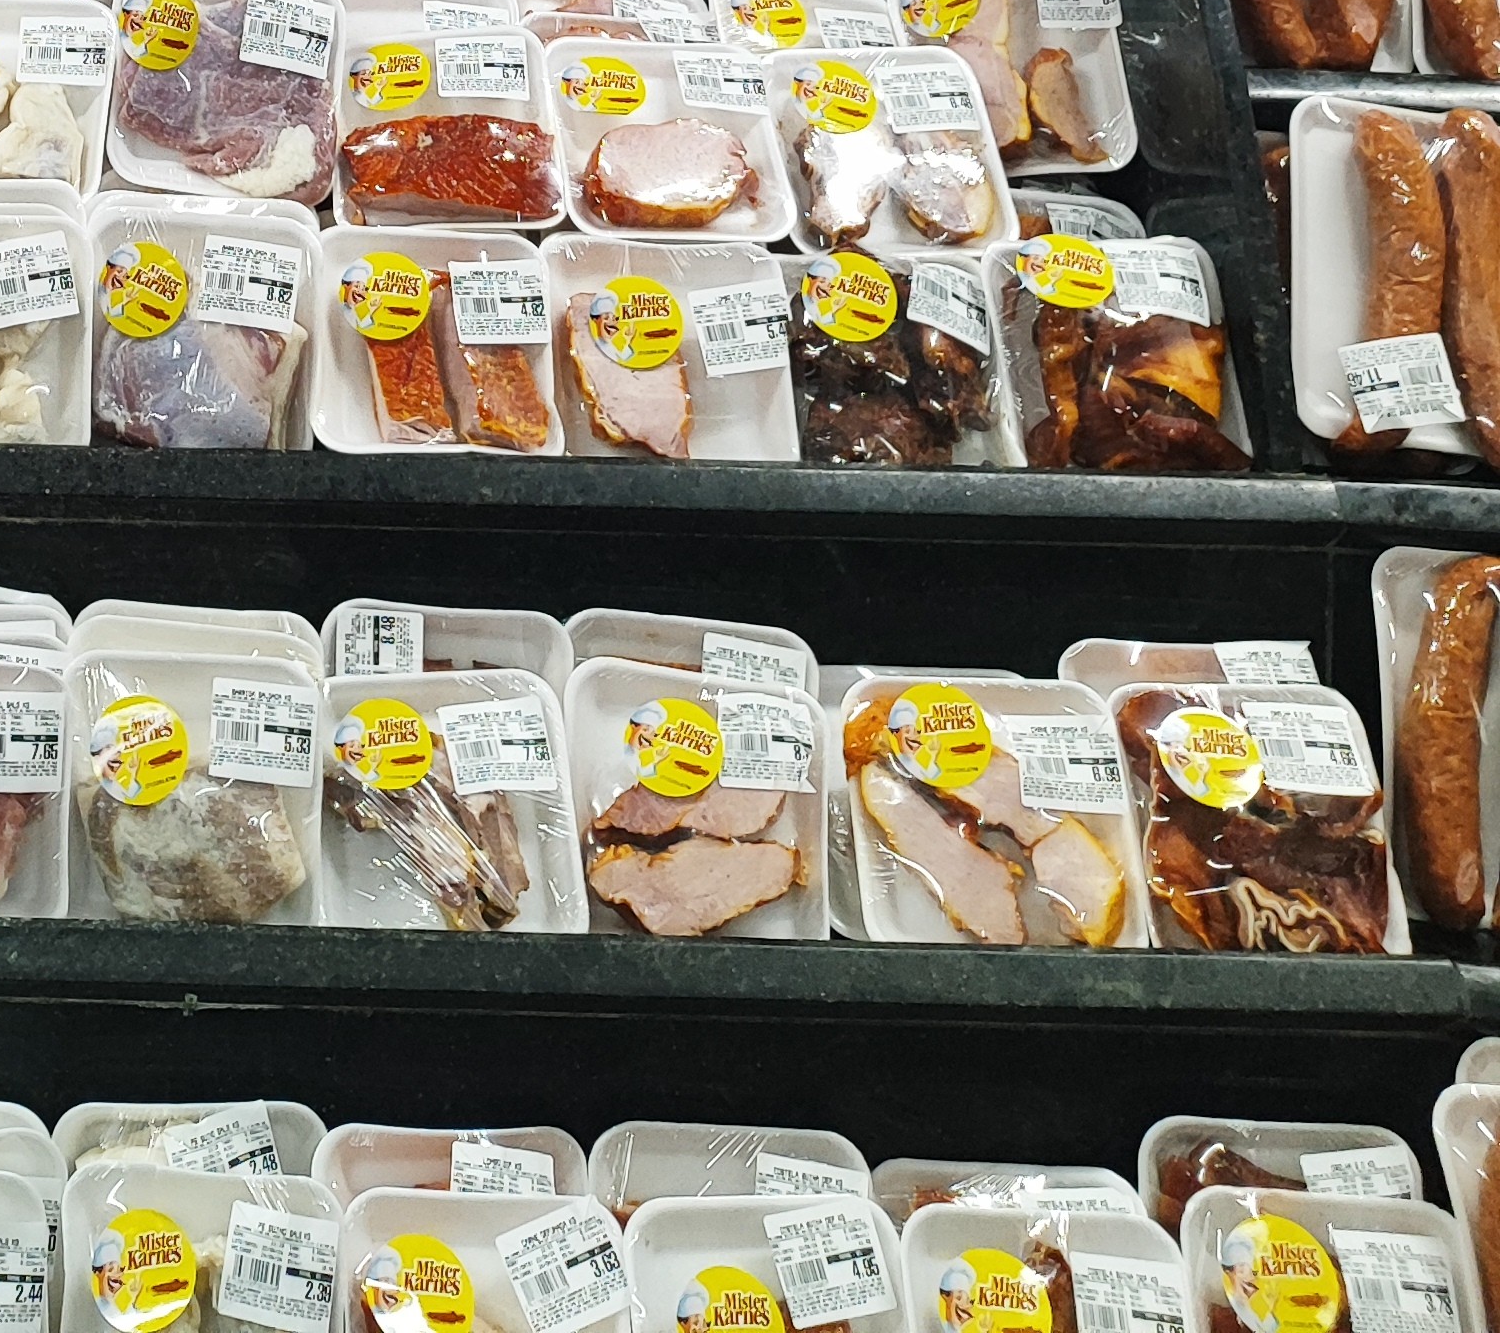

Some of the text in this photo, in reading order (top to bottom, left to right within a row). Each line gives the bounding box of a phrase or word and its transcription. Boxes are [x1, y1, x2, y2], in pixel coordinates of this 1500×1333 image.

[149, 8, 191, 31] Karnes
[162, 2, 194, 20] Mister
[378, 63, 420, 73] Karnes
[388, 55, 420, 66] Mister
[591, 76, 634, 90] Karnes
[602, 71, 636, 82] Mister
[835, 77, 868, 93] Mister
[1051, 254, 1102, 275] Karnes
[1065, 249, 1102, 267] Mister
[131, 268, 178, 301] Karnes
[149, 263, 181, 289] Mister
[385, 271, 421, 287] Mister
[852, 273, 890, 293] Mister
[372, 279, 419, 296] Karnes
[837, 278, 885, 306] Karnes
[630, 294, 668, 305] Mister
[622, 304, 669, 319] Karnes
[932, 704, 972, 717] Mister
[379, 718, 418, 733] Mister
[679, 720, 717, 745] Mister
[921, 715, 975, 733] Karnes
[368, 729, 418, 746] Karnes
[660, 726, 712, 755] Karnes
[1202, 728, 1244, 744] Mister
[31, 743, 58, 759] 7,65
[1192, 737, 1246, 757] Karnes
[138, 1233, 180, 1251] Mister
[1270, 1242, 1316, 1260] Mister
[127, 1247, 182, 1271] Karnes
[1261, 1255, 1320, 1276] Karnes
[416, 1260, 460, 1280] Mister
[404, 1272, 460, 1296] Karnes
[992, 1276, 1036, 1298] Mister
[16, 1285, 43, 1303] 2,44
[724, 1292, 767, 1311] Mister
[979, 1286, 1037, 1311] Karnes
[713, 1305, 770, 1326] Karnes
